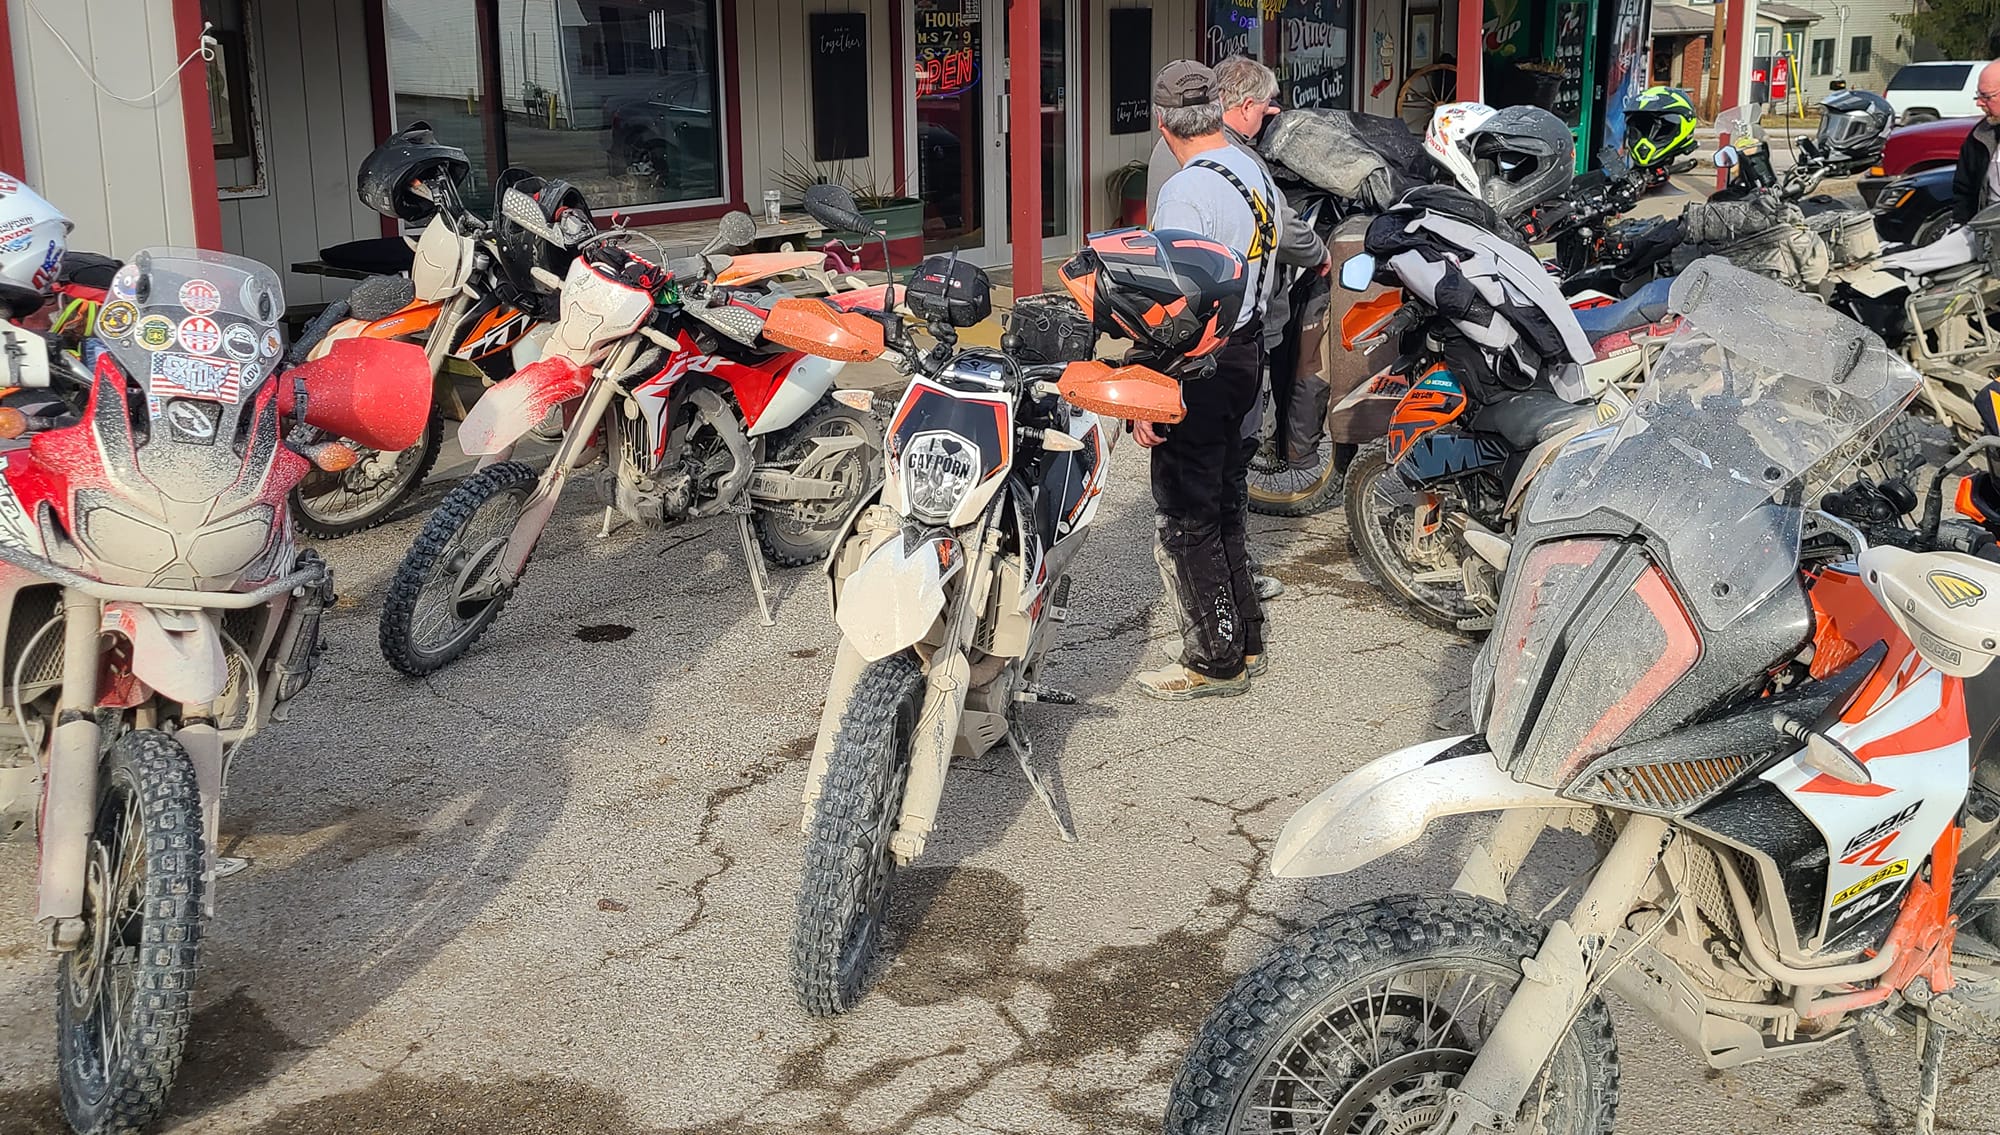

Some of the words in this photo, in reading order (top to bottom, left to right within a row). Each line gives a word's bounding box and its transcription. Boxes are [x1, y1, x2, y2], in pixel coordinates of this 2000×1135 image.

[925, 12, 970, 28] HOUR
[1288, 16, 1334, 51] Diner
[1293, 85, 1322, 109] Carry
[1321, 71, 1344, 100] Out
[242, 364, 260, 387] ADV
[933, 453, 972, 479] PORN
[1842, 798, 1925, 853] 1290
[1834, 863, 1904, 905] ACERBIS
[1835, 892, 1881, 924] KTM
